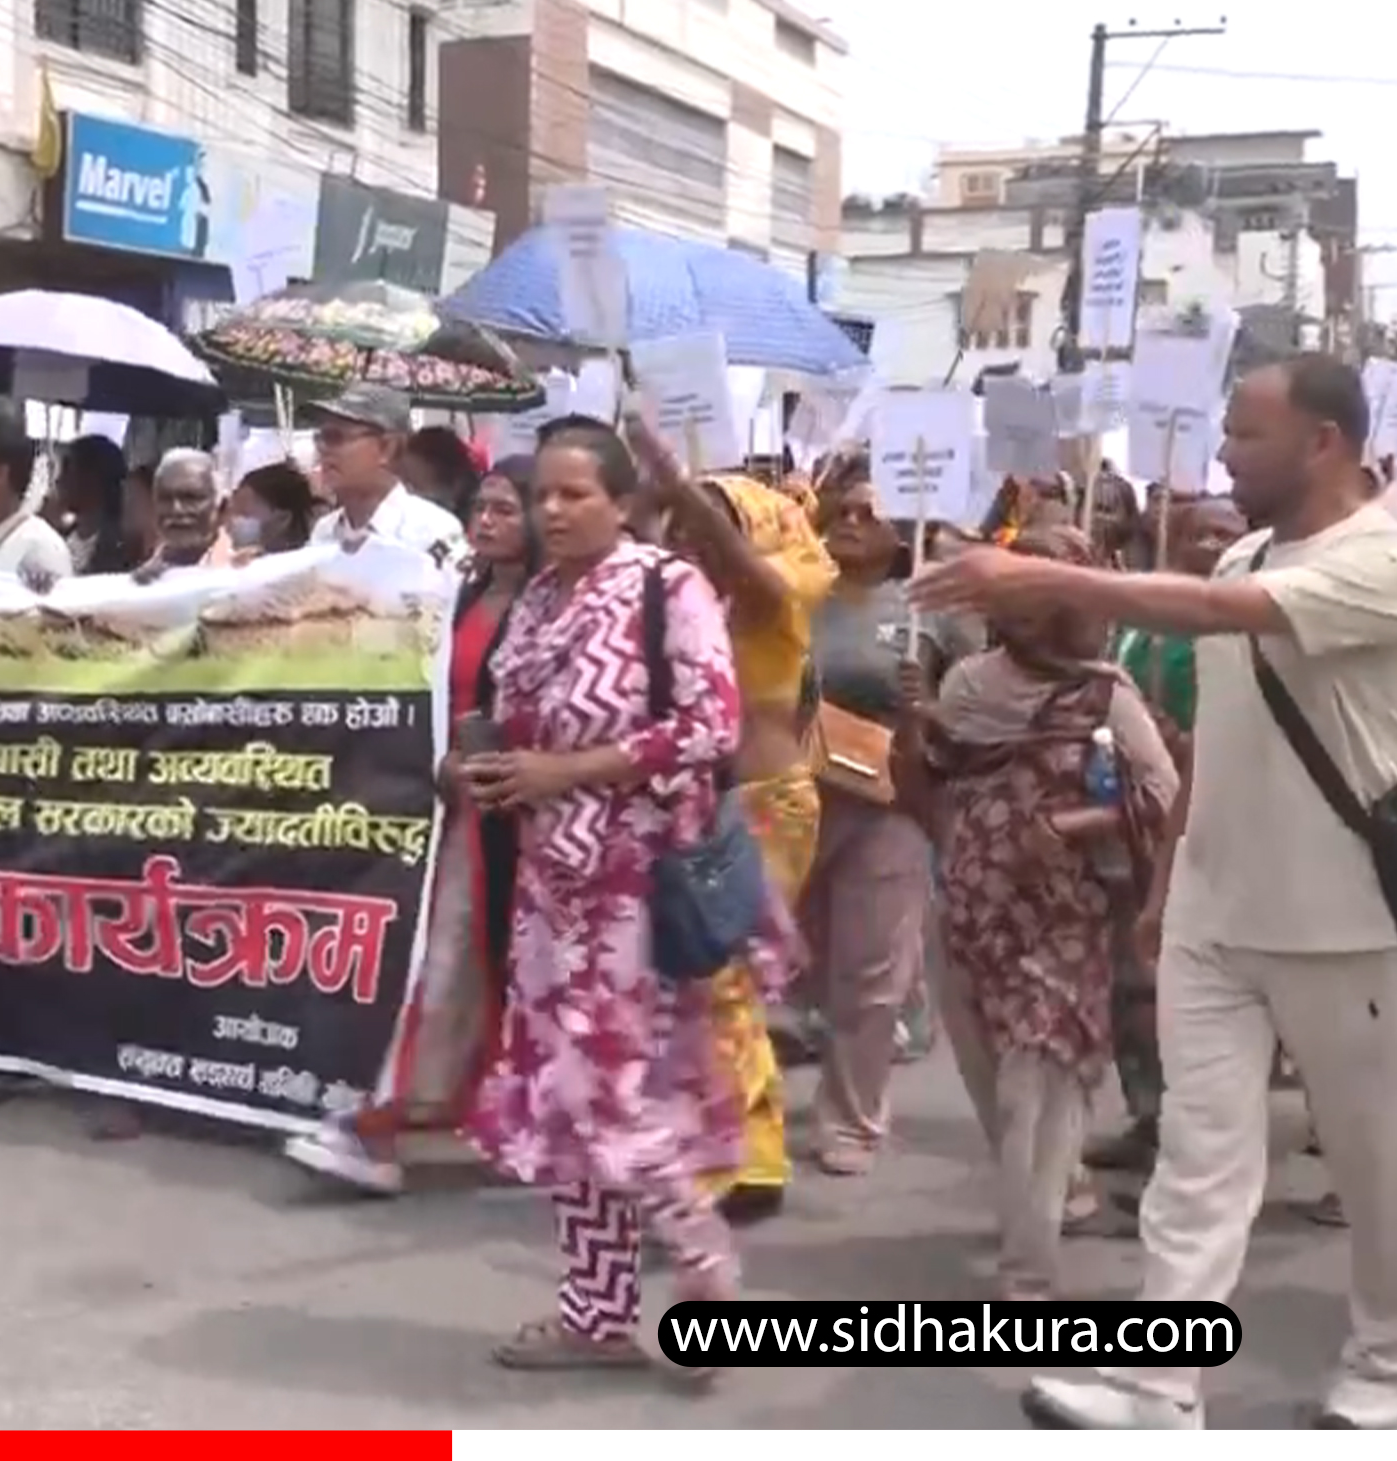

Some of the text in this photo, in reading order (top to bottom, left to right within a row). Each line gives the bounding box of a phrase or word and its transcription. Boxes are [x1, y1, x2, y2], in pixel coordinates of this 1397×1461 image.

[78, 151, 172, 211] Marvel
[70, 747, 139, 782] तथा
[148, 741, 334, 792] अव्यवस्थित
[33, 797, 198, 841] सरकारको
